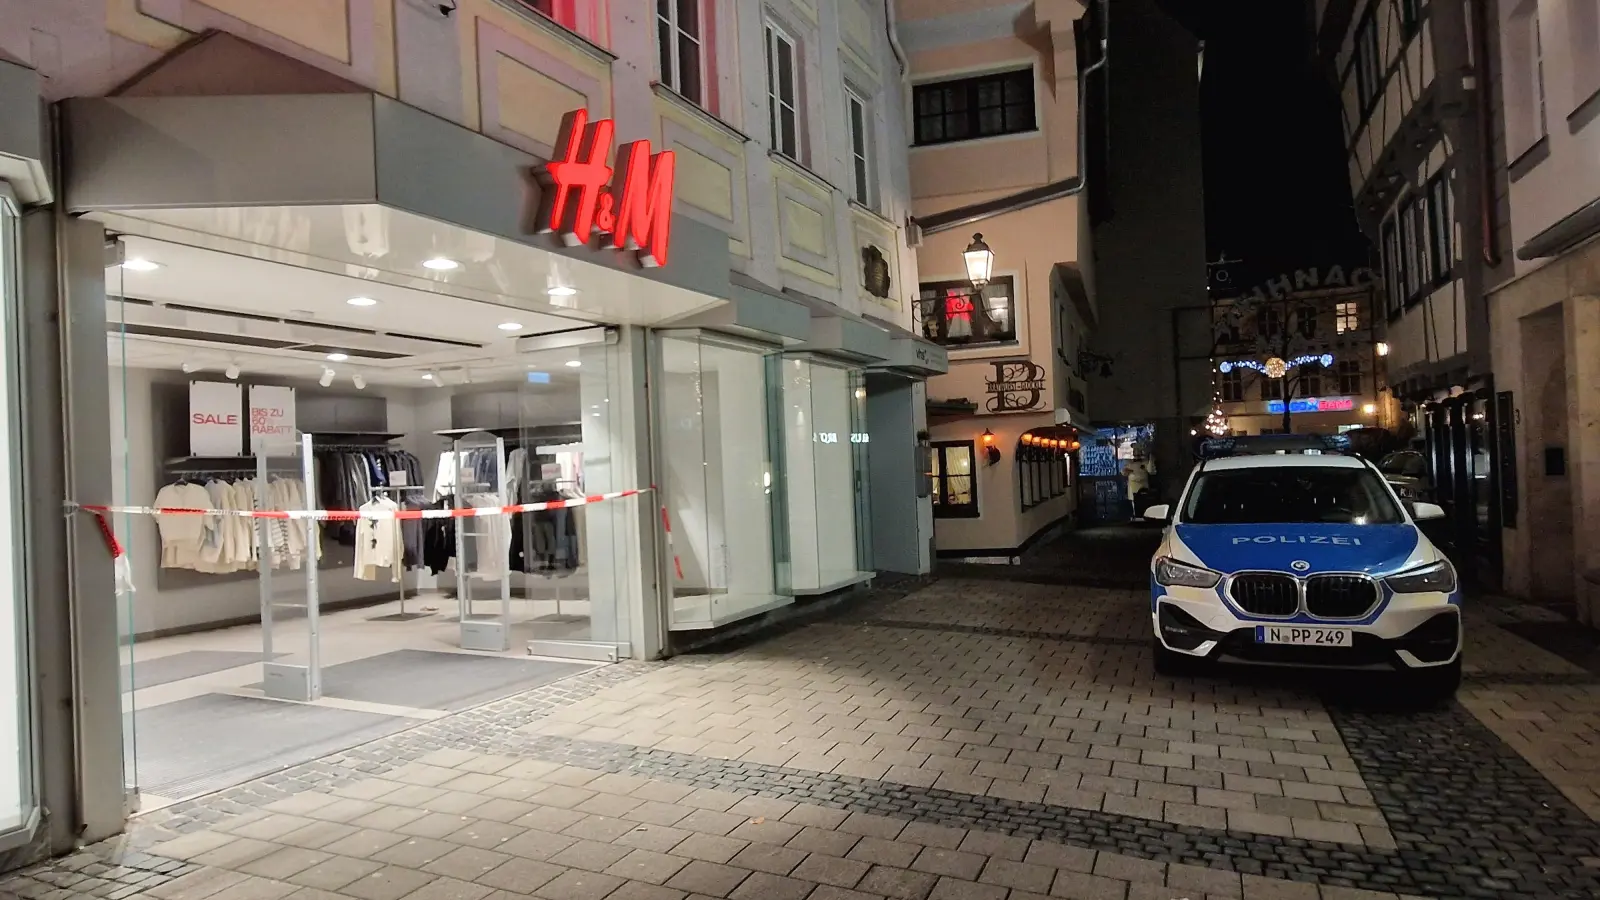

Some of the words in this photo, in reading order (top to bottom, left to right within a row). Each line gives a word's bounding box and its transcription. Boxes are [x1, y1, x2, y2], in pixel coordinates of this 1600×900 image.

[547, 108, 675, 267] H&M
[252, 408, 267, 416] BIS
[270, 408, 284, 417] ZU
[193, 413, 238, 425] SALE
[252, 425, 293, 435] RABATT
[1232, 535, 1361, 546] POLIZEI
[1270, 628, 1281, 642] N
[1291, 629, 1311, 643] PP
[1315, 630, 1345, 645] 249
